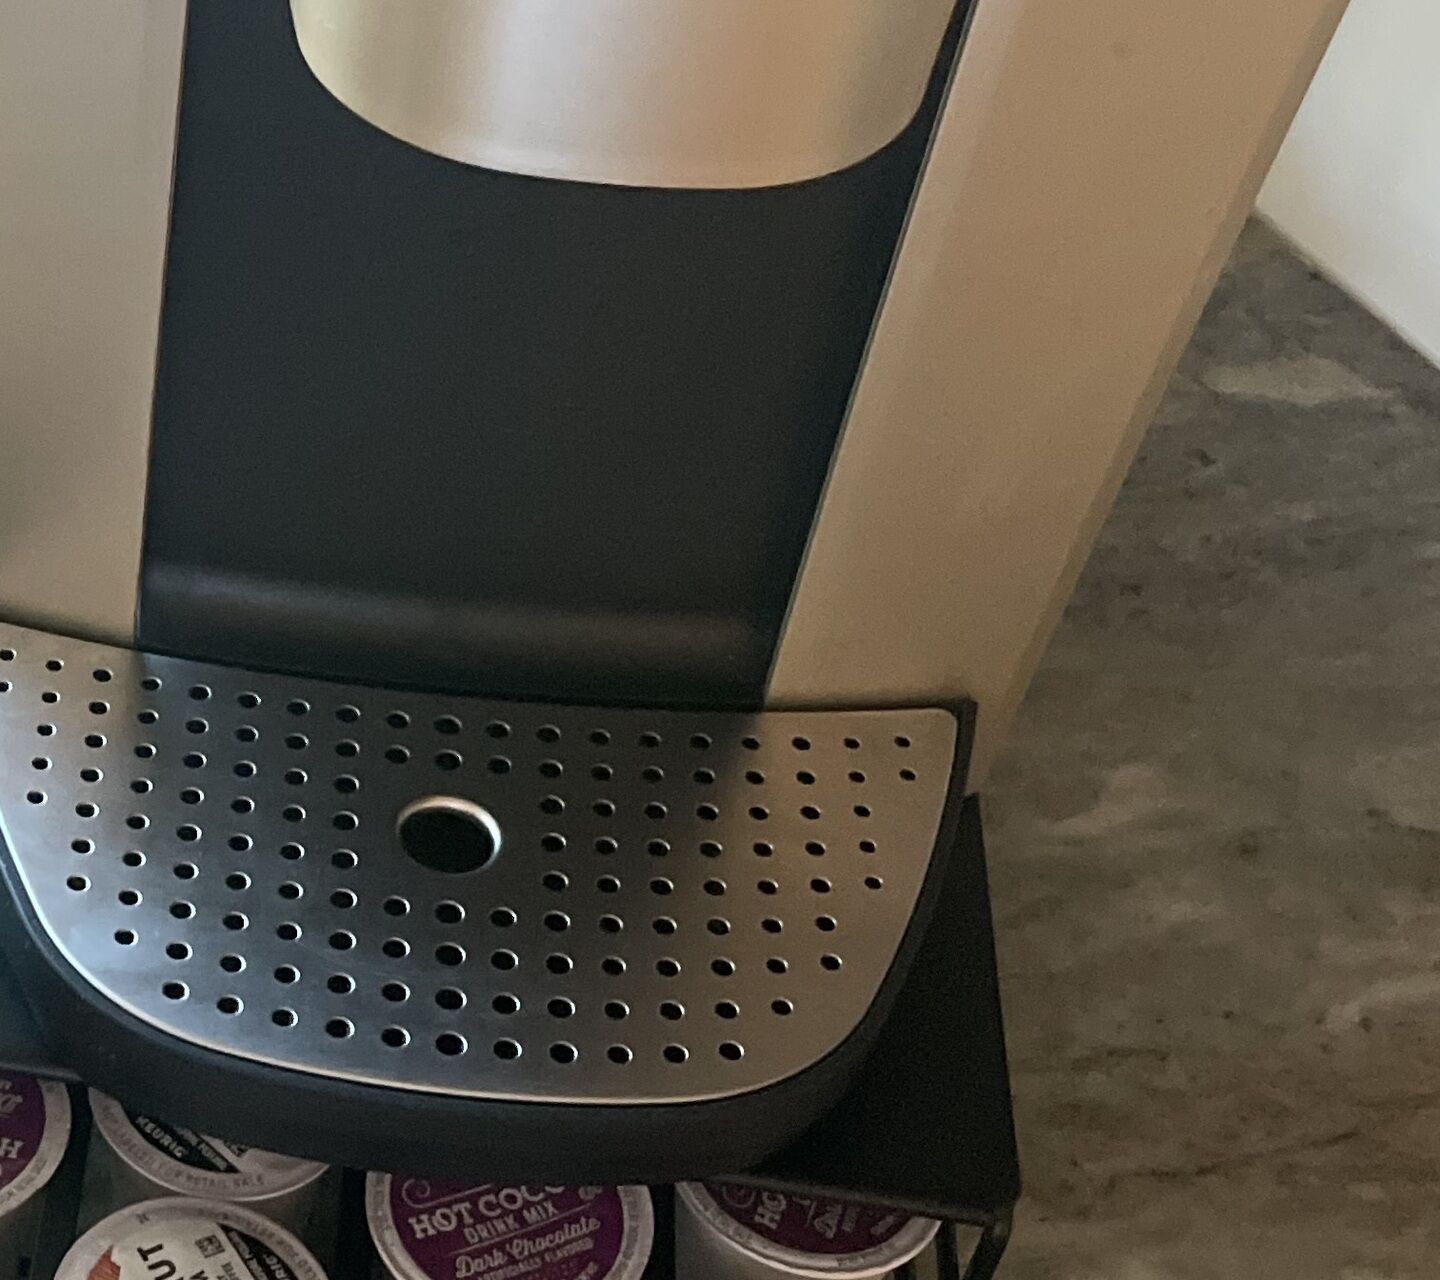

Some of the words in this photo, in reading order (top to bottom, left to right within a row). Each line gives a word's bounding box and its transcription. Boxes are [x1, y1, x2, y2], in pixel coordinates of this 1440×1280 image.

[409, 1200, 476, 1240] HOT
[463, 1214, 521, 1245] DRINK
[522, 1199, 560, 1226] MIX
[456, 1248, 509, 1278] Dark
[506, 1216, 601, 1260] Chocolate
